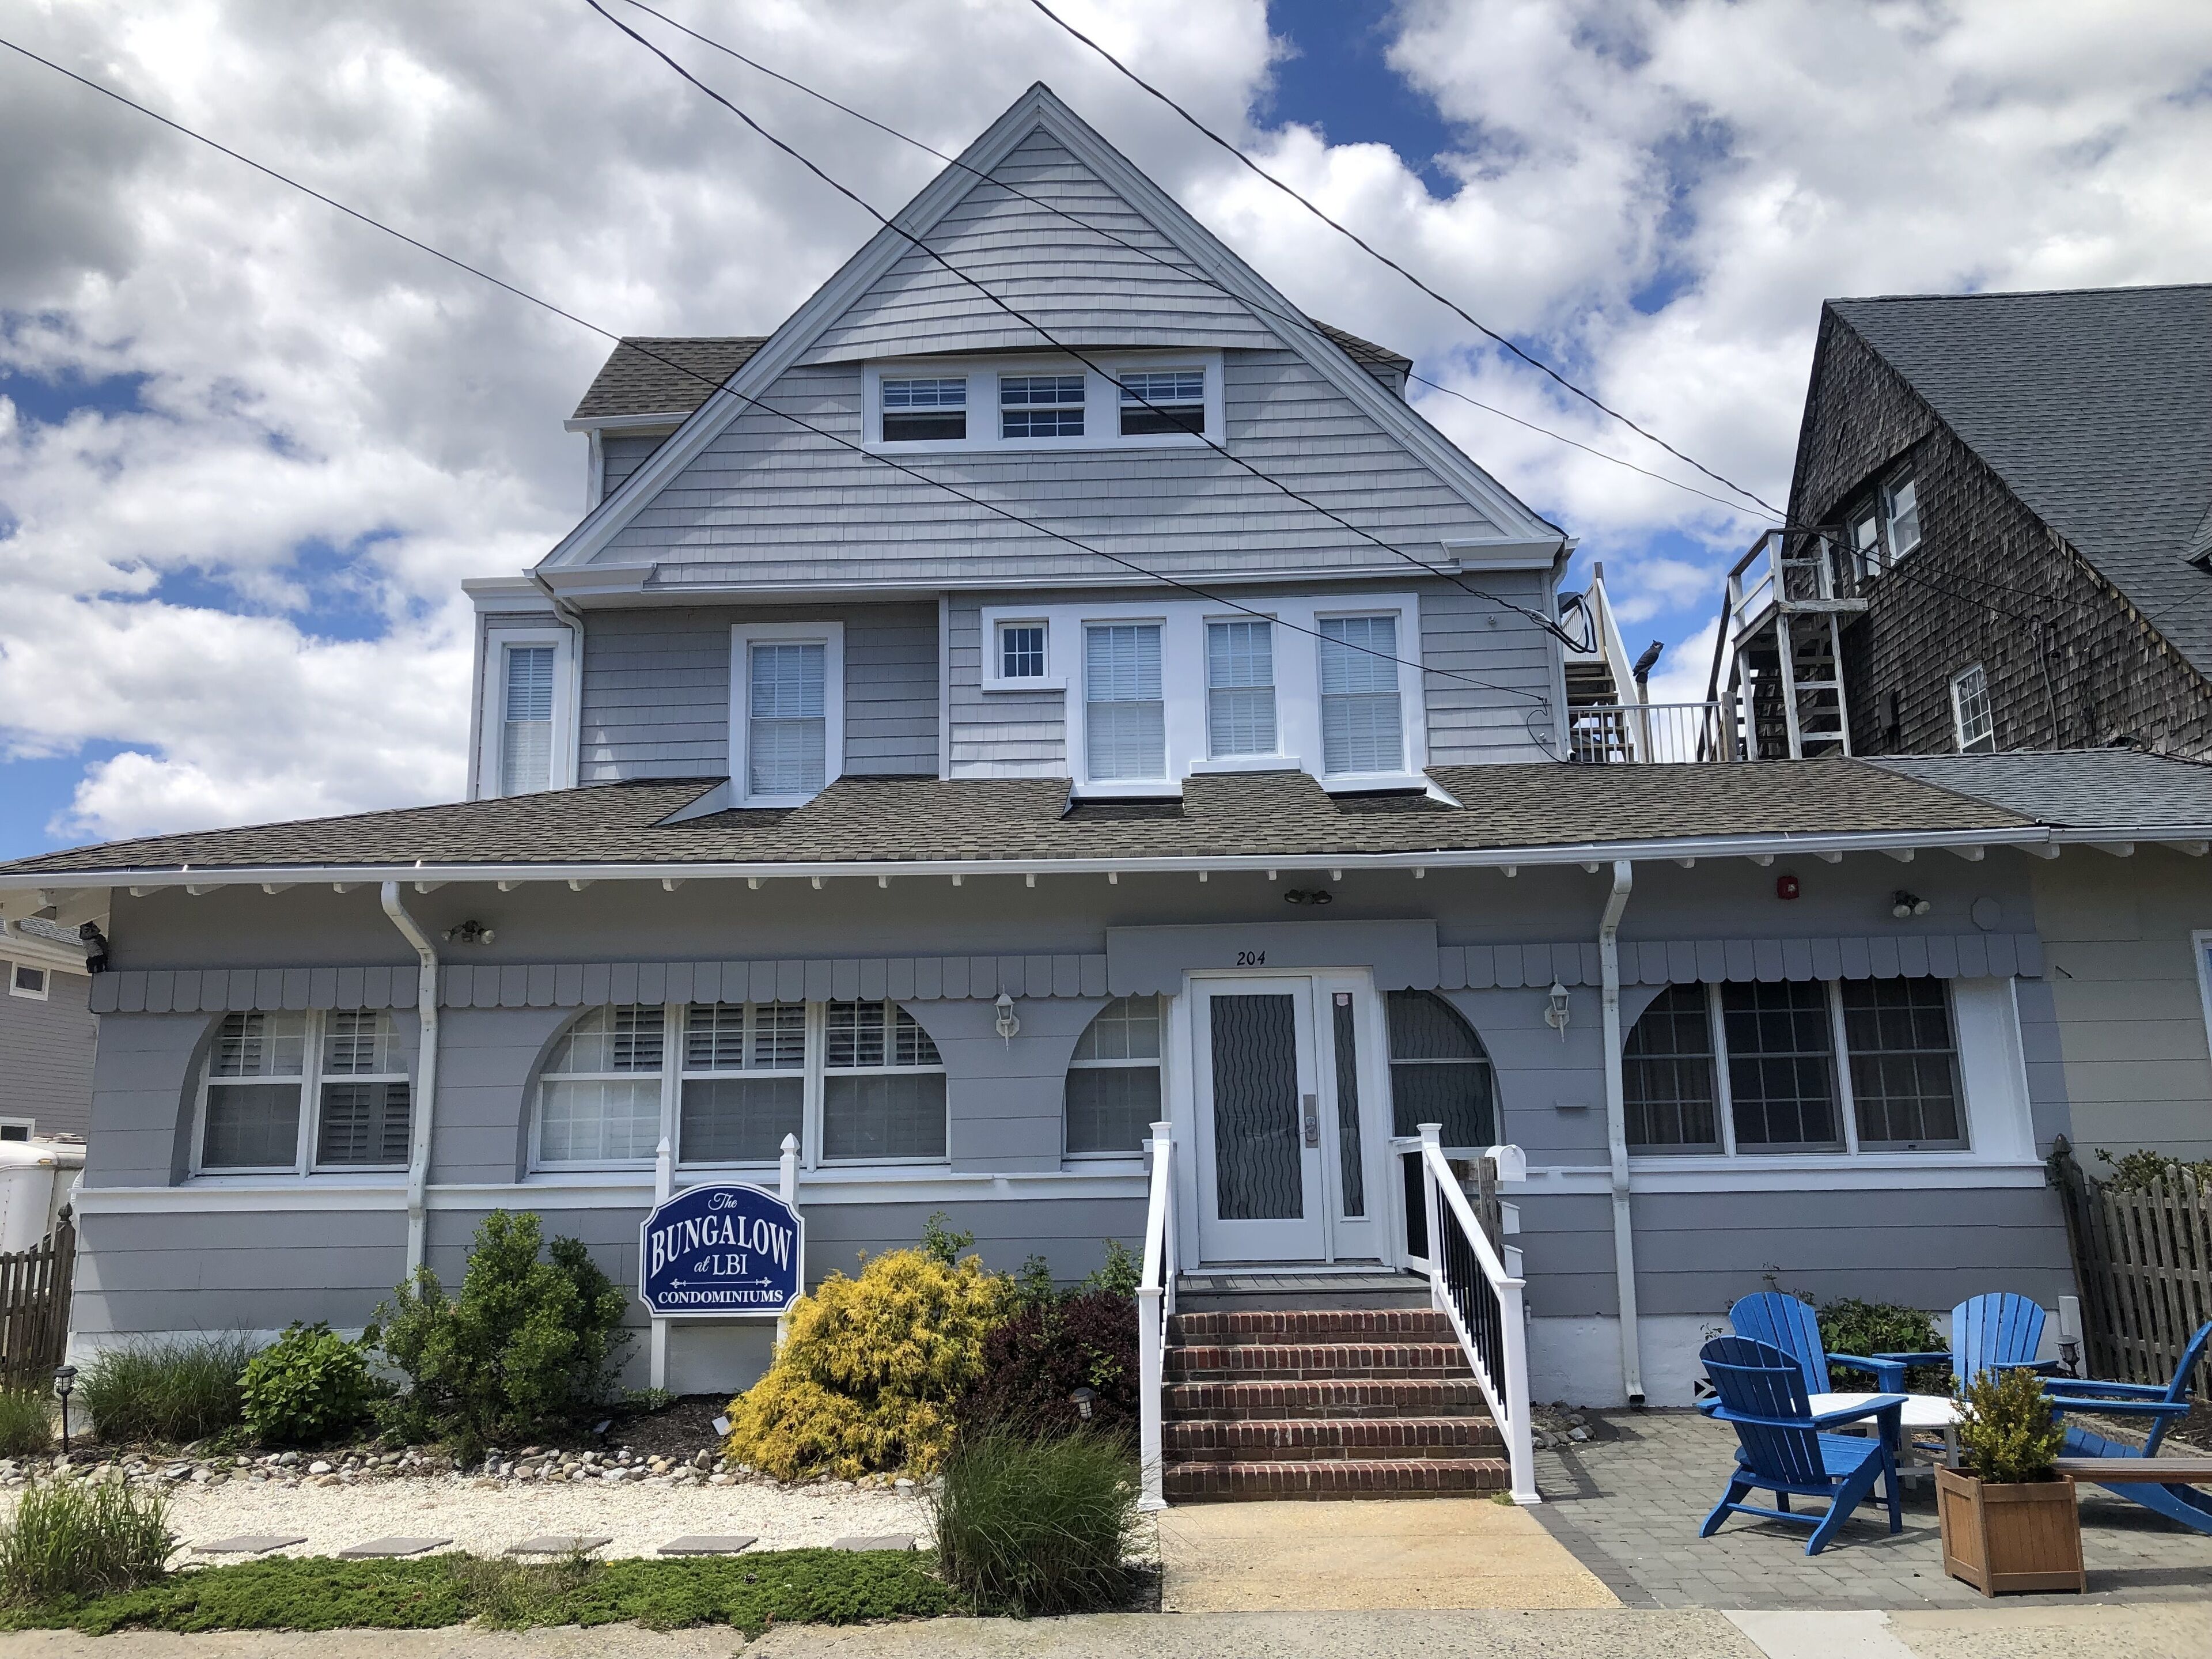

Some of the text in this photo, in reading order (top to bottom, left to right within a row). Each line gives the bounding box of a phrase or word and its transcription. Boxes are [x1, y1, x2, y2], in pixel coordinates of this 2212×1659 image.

[1237, 950, 1265, 965] 204
[708, 1192, 737, 1210] The
[650, 1215, 793, 1279] BUNGALOW
[694, 1253, 748, 1276] at LBI
[658, 1290, 783, 1304] CONDOMINIUMS
